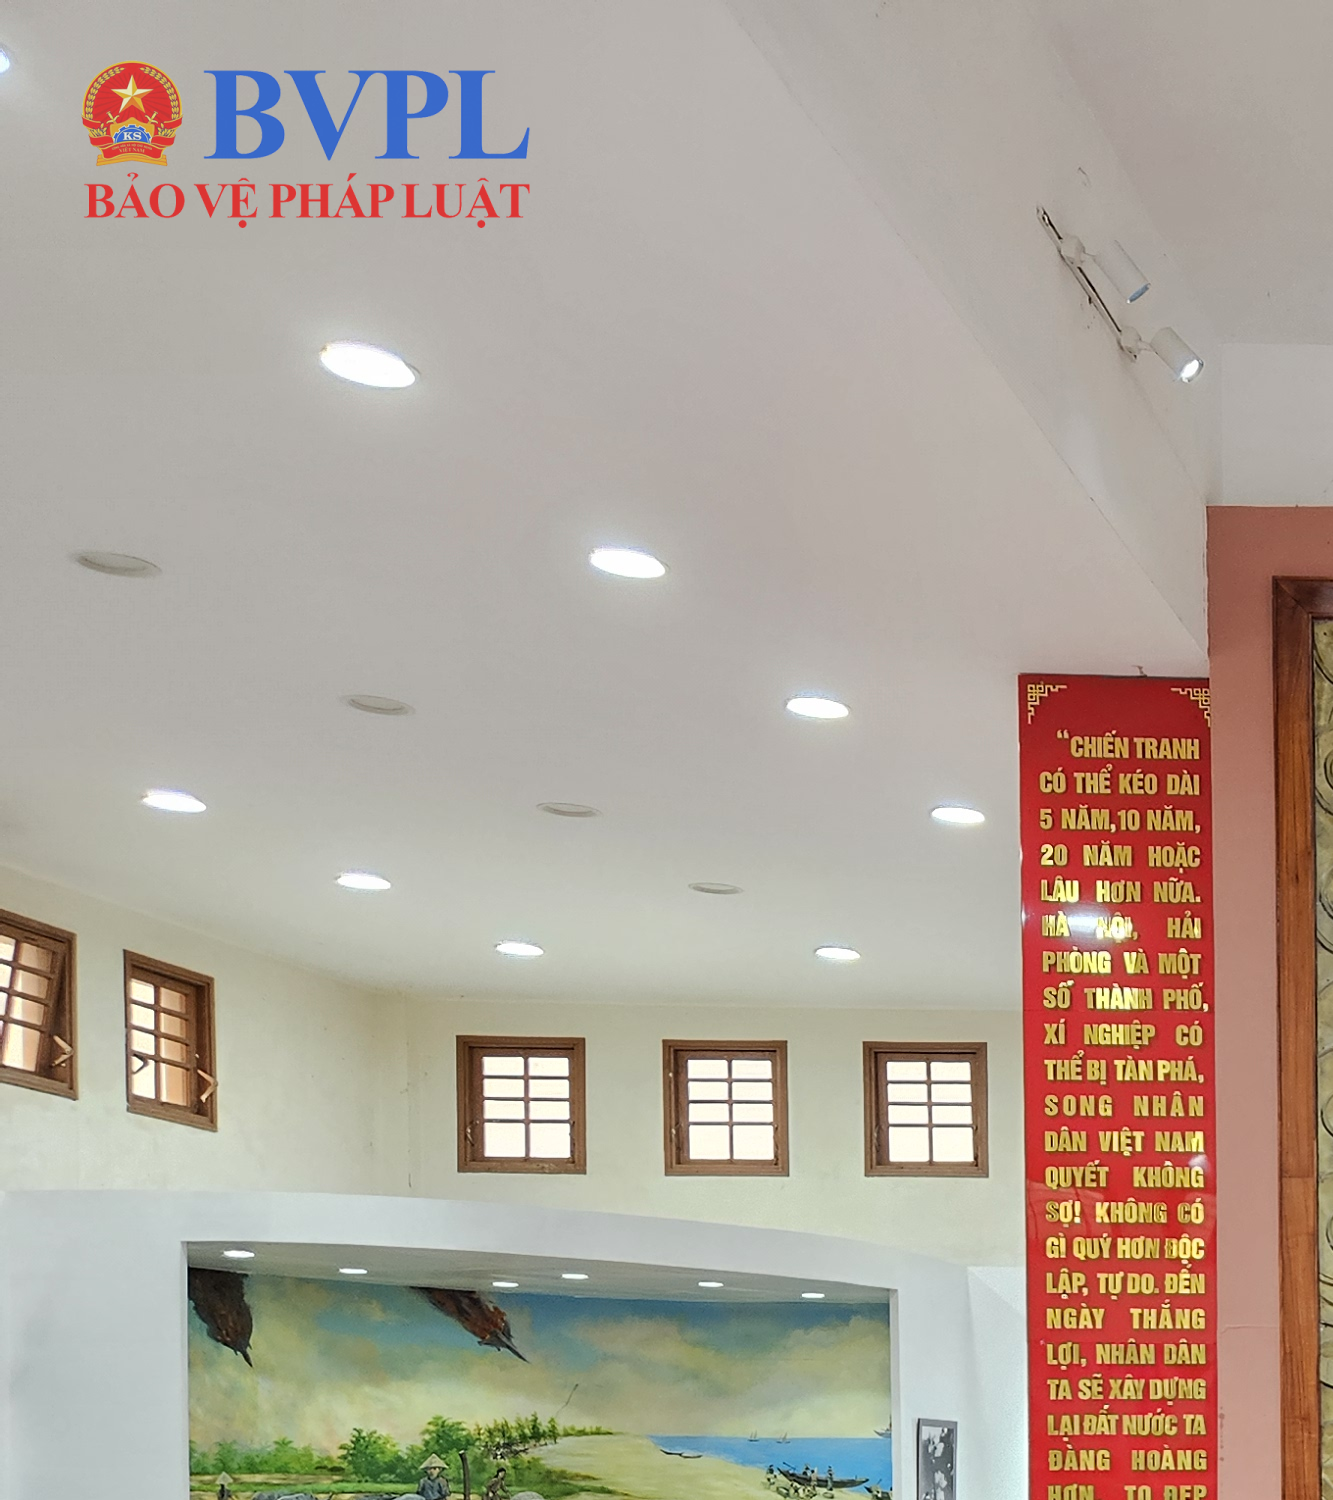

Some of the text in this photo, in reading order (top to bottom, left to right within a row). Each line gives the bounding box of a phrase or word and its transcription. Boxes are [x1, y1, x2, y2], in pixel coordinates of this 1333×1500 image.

[1134, 738, 1199, 759] TRANH
[1040, 766, 1199, 795] CÓ THỂ KÉO DÀI
[1040, 809, 1052, 830] 5
[1147, 807, 1200, 833] NĂM,
[1041, 842, 1200, 874] 20 NĂM HOẶC
[1041, 877, 1201, 904] LÂU HƠN NỮA.
[1041, 911, 1201, 943] HÀ NỘI, HẢI
[1042, 947, 1202, 979] PHÒNG VÀ MỘT
[1043, 980, 1209, 1012] SỐ THÀNH PHỐ,
[1044, 1020, 1203, 1049] XÍ NGHIỆP CÓ
[1044, 1051, 1204, 1085] THỂ BỊ TÀN PHÁ,
[1045, 1092, 1204, 1117] SONG NHÂN
[1045, 1126, 1205, 1157] DÂN VIỆT NAM
[1045, 1158, 1204, 1190] QUYẾT KHÔNG
[1046, 1198, 1205, 1228] SỢ! KHÔNG CÓ
[1046, 1232, 1066, 1258] GÌ
[1117, 1236, 1160, 1260] HƠN
[1164, 1234, 1206, 1264] ĐỘC
[1046, 1265, 1205, 1300] LẬP, TỰ DO. ĐẾN
[1046, 1299, 1205, 1330] NGÀY THẮNG
[1047, 1339, 1206, 1369] LỢI, NHÂN DÂN
[1047, 1373, 1206, 1405] TA SẼ XÂY DỰNG
[1047, 1404, 1206, 1441] LẠI ĐẤT NƯỚC TA
[1048, 1444, 1207, 1471] ĐÀNG HOÀNG
